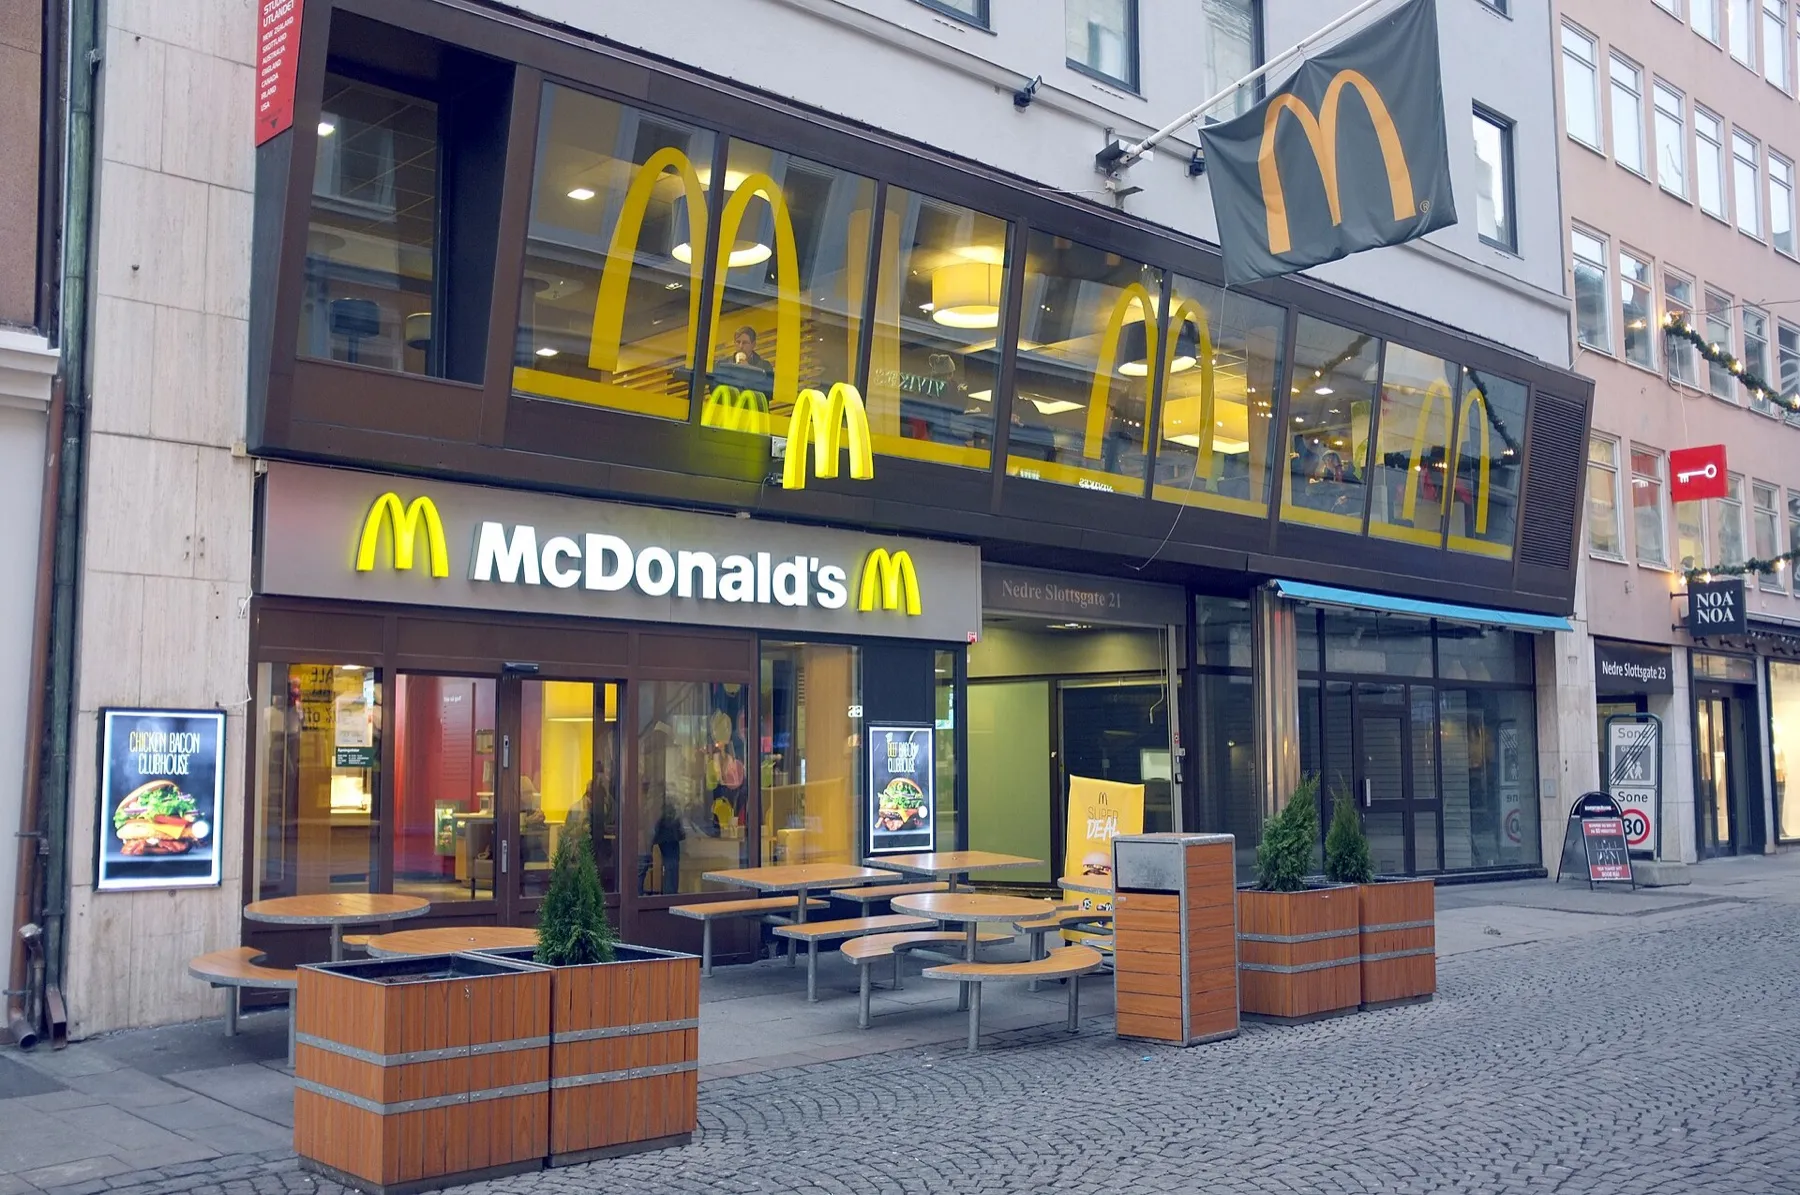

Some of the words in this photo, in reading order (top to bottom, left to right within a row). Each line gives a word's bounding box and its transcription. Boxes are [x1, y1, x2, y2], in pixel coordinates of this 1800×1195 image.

[260, 101, 271, 112] USA
[471, 521, 848, 609] McDonald's
[1002, 579, 1042, 599] Nedre
[1045, 583, 1105, 609] Slottsgate
[1108, 591, 1121, 608] 21
[1696, 591, 1734, 608] NOA
[1697, 608, 1735, 624] NOA
[1602, 661, 1623, 676] Nedre
[1624, 663, 1658, 682] Slottsgate
[1658, 667, 1667, 680] 23
[129, 731, 167, 753] CHICKEN
[169, 732, 201, 754] BACON
[138, 753, 191, 775] CLUBHOUSE
[1617, 791, 1648, 803] Sone
[1086, 816, 1121, 842] DEAL
[1623, 819, 1644, 836] 30
